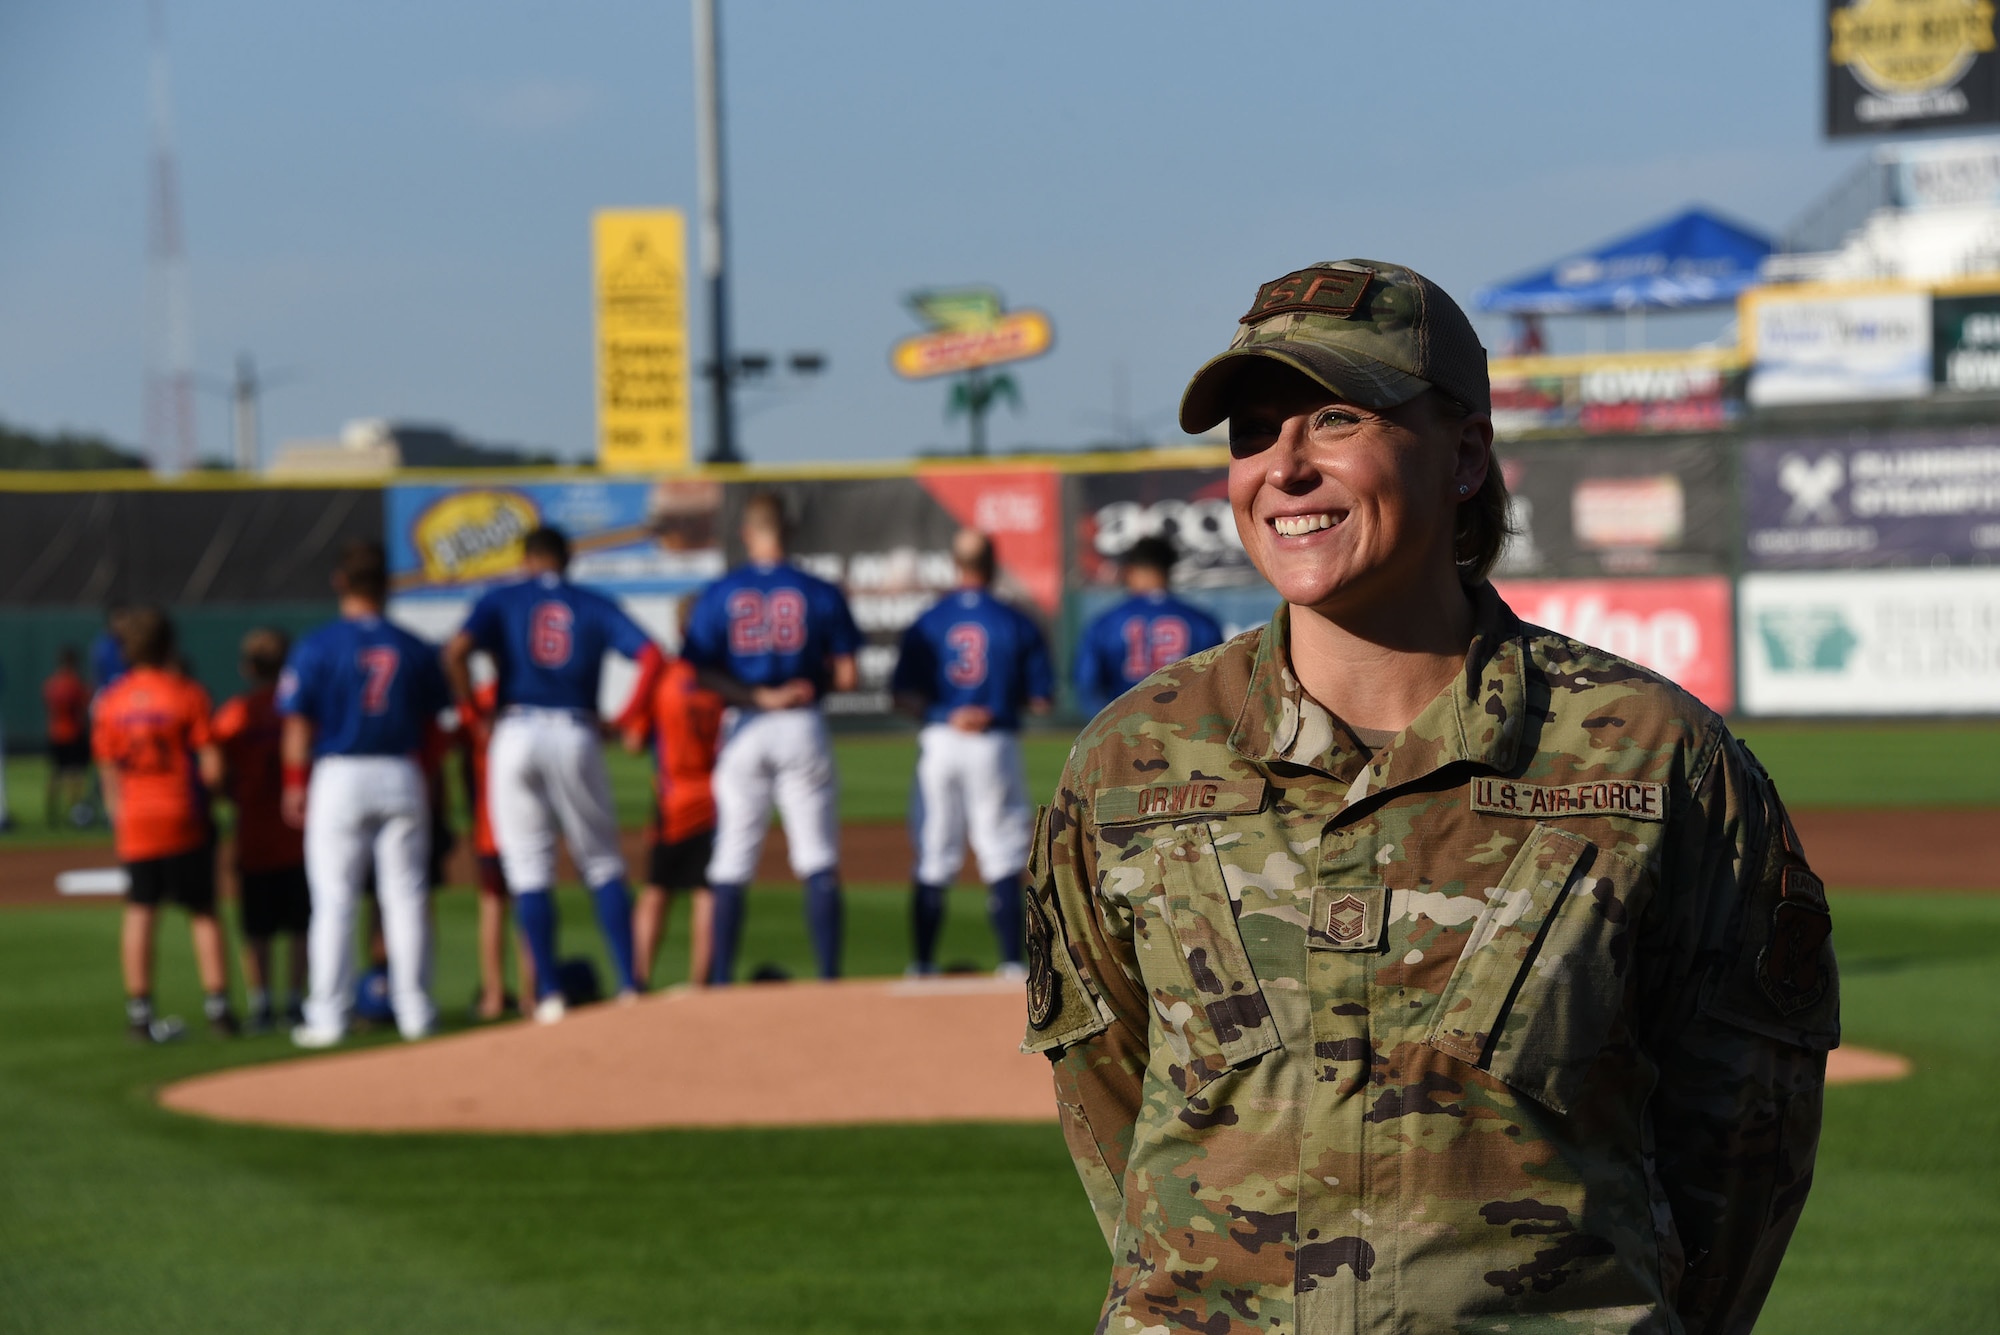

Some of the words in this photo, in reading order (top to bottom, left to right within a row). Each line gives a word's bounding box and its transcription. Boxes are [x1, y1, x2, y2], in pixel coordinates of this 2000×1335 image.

[1262, 273, 1355, 309] SF
[528, 600, 574, 669] 6
[726, 587, 808, 656] 28
[946, 621, 989, 689] 3
[1123, 615, 1190, 682] 12
[356, 645, 399, 717] 7
[1137, 784, 1218, 816] ORWIG
[1476, 780, 1523, 811] U.S.
[1530, 787, 1570, 813] AIR
[1577, 783, 1656, 814] FORCE
